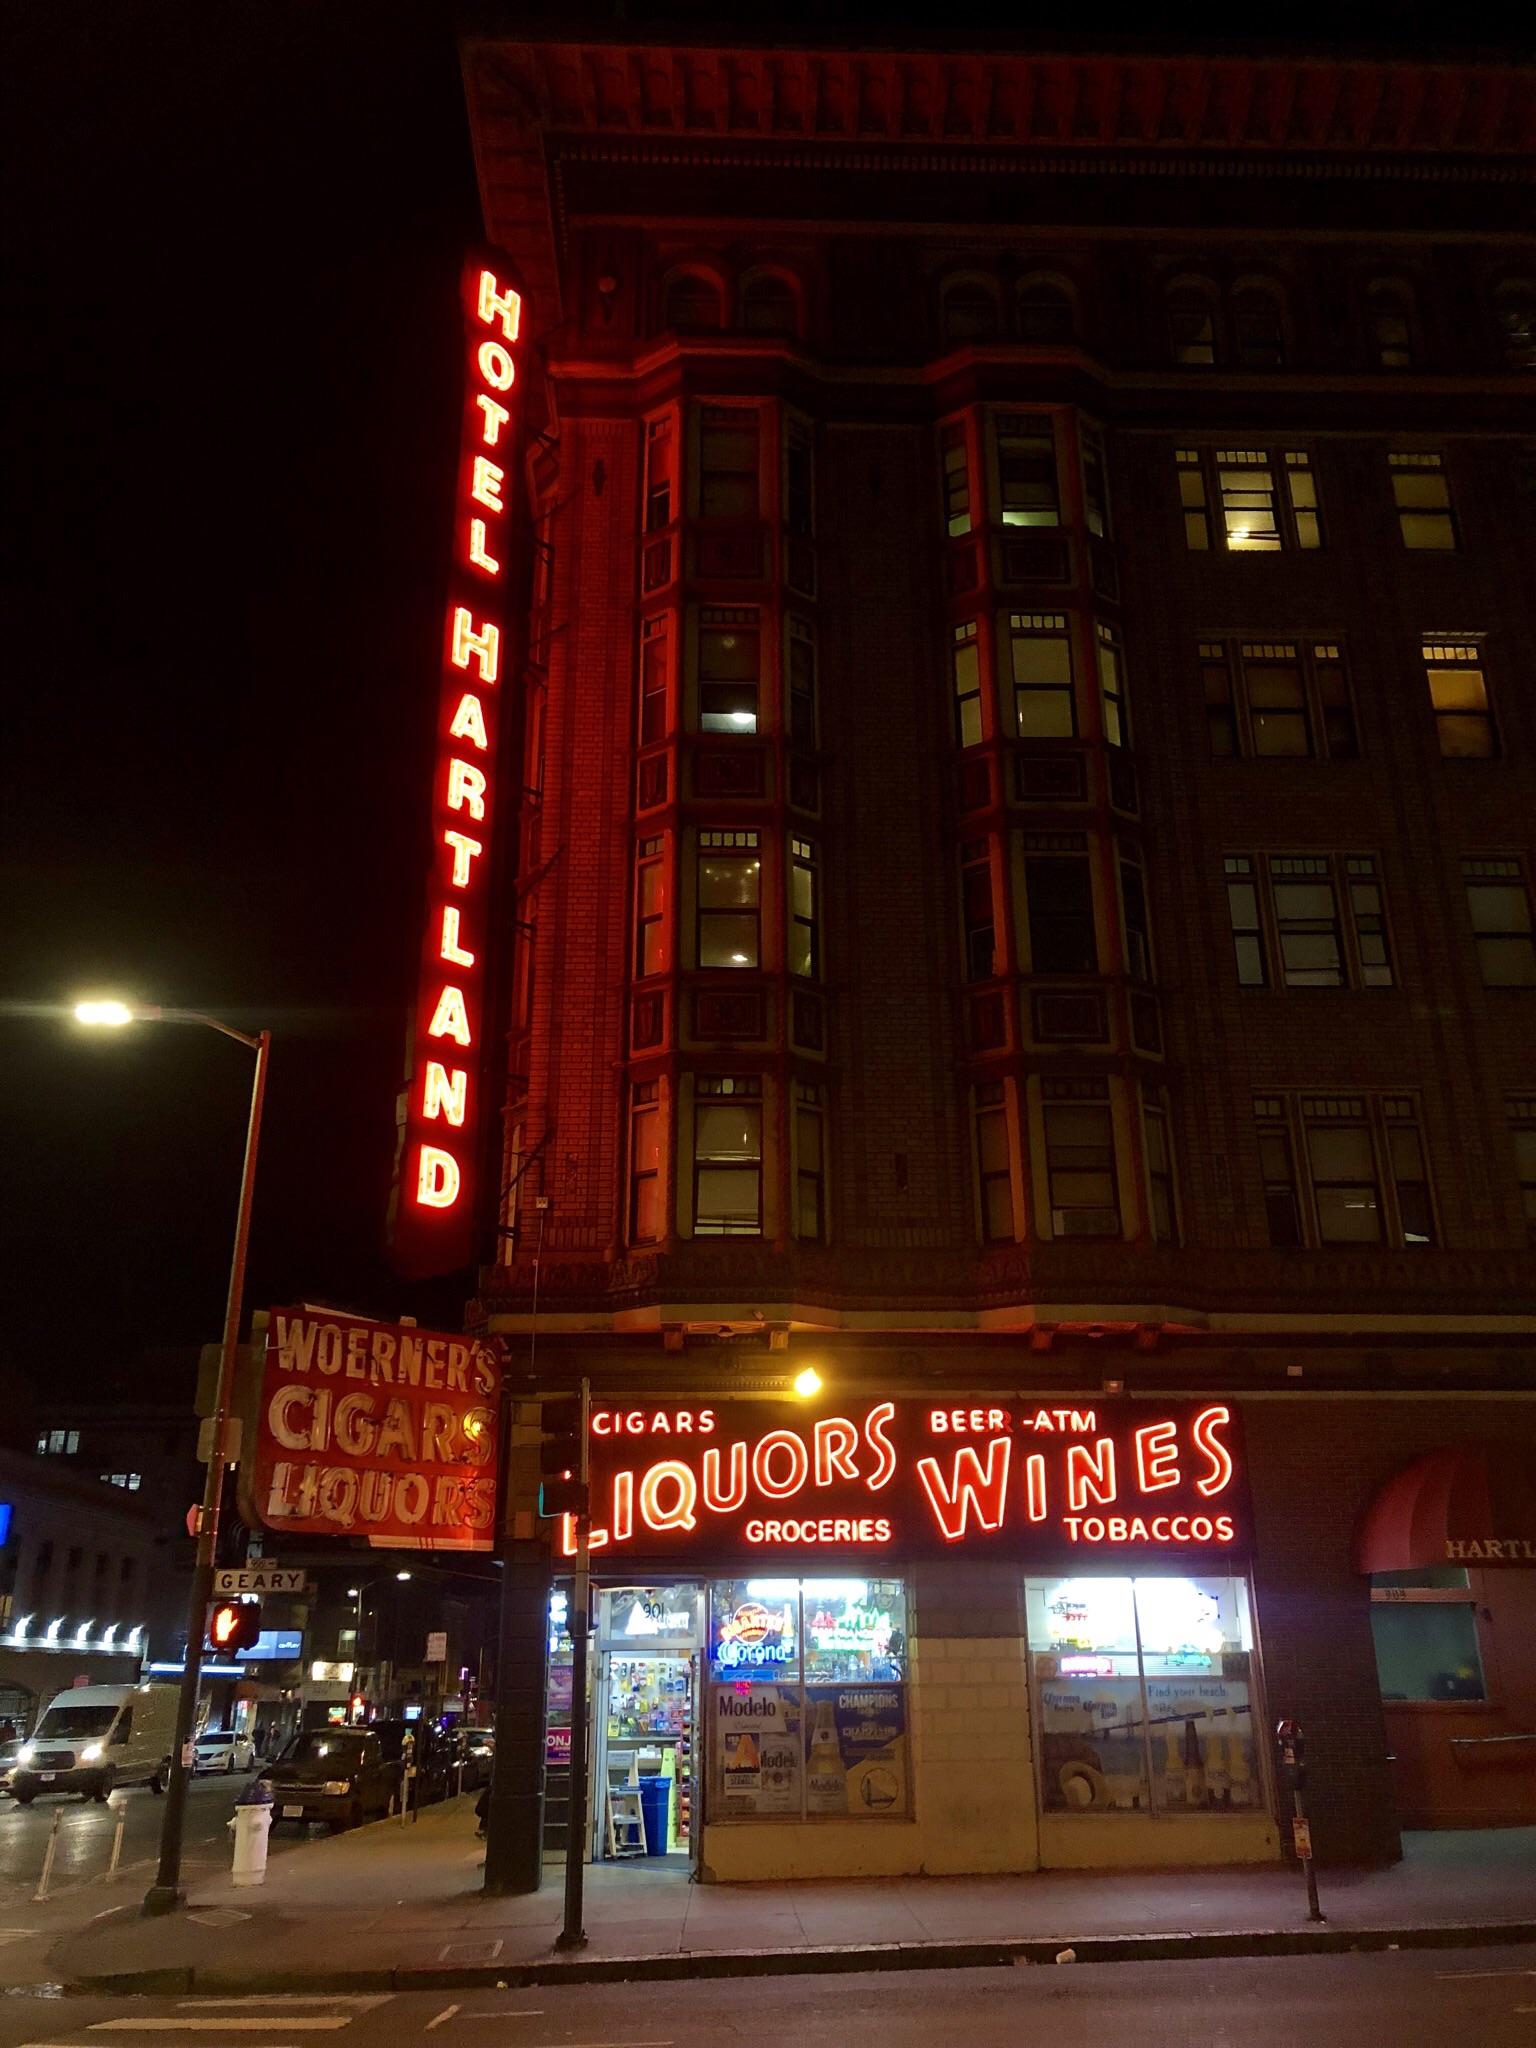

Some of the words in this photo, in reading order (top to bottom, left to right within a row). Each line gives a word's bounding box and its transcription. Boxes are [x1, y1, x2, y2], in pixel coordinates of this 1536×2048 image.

[470, 270, 521, 575] HOTEL
[415, 606, 499, 1208] HARTLAND
[276, 1316, 497, 1395] WOERNER'S
[268, 1384, 497, 1467] CIGARS
[591, 1409, 716, 1435] CIGARS
[930, 1409, 1005, 1433] BEER
[267, 1460, 497, 1530] LIQUORS
[562, 1402, 897, 1556] LIQUORS
[917, 1406, 1233, 1539] WINES
[745, 1519, 892, 1544] GROCERIES
[1063, 1516, 1235, 1542] TOBACCOS
[221, 1574, 300, 1589] GEARY
[717, 1640, 786, 1668] Corona
[719, 1695, 776, 1717] Modelo
